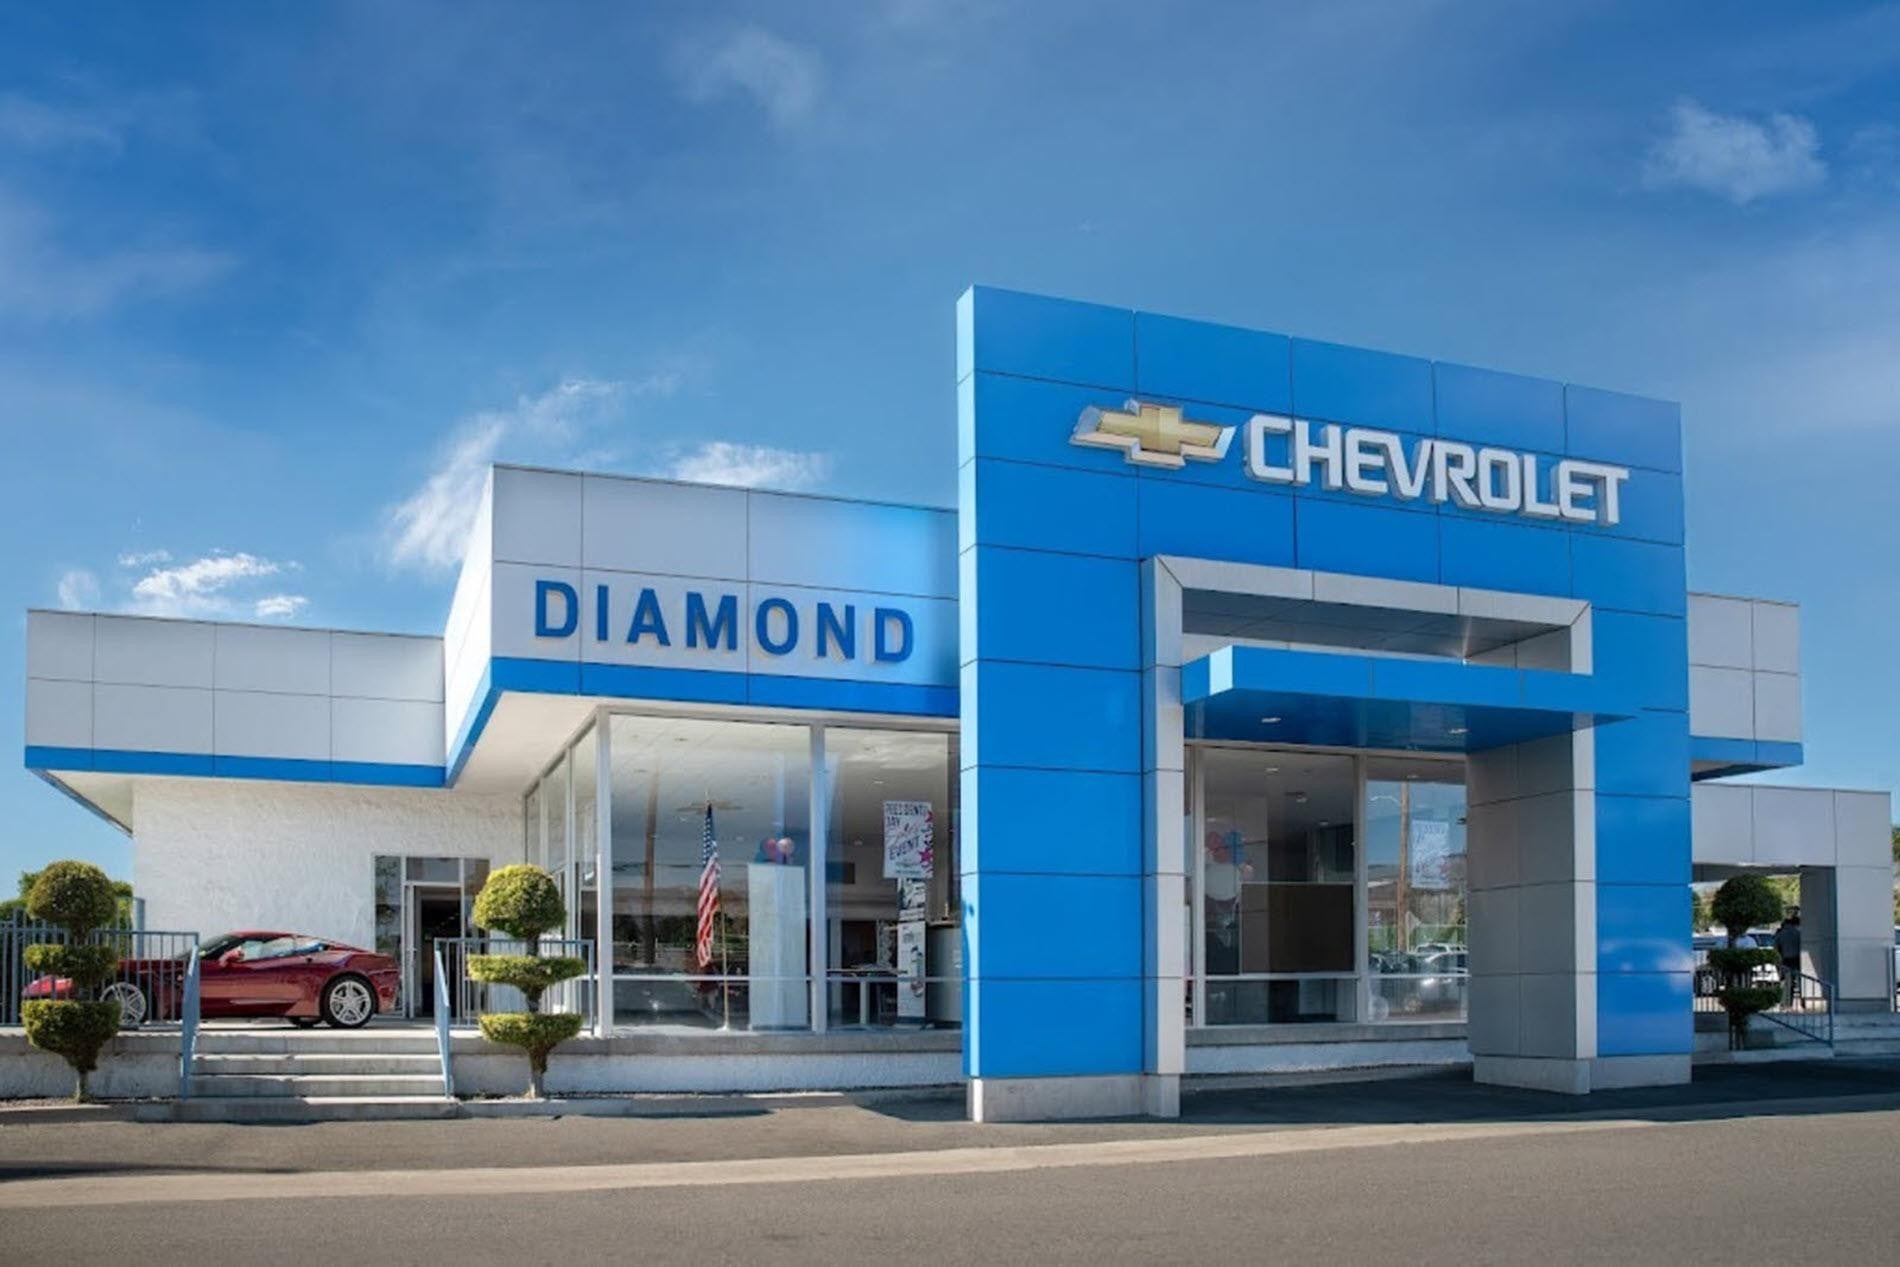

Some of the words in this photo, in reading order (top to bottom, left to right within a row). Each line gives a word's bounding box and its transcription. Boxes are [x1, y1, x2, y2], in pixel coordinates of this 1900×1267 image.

[1244, 413, 1629, 526] CHEVROLET
[535, 580, 914, 664] DIAMOND
[889, 836, 920, 860] EVENT
